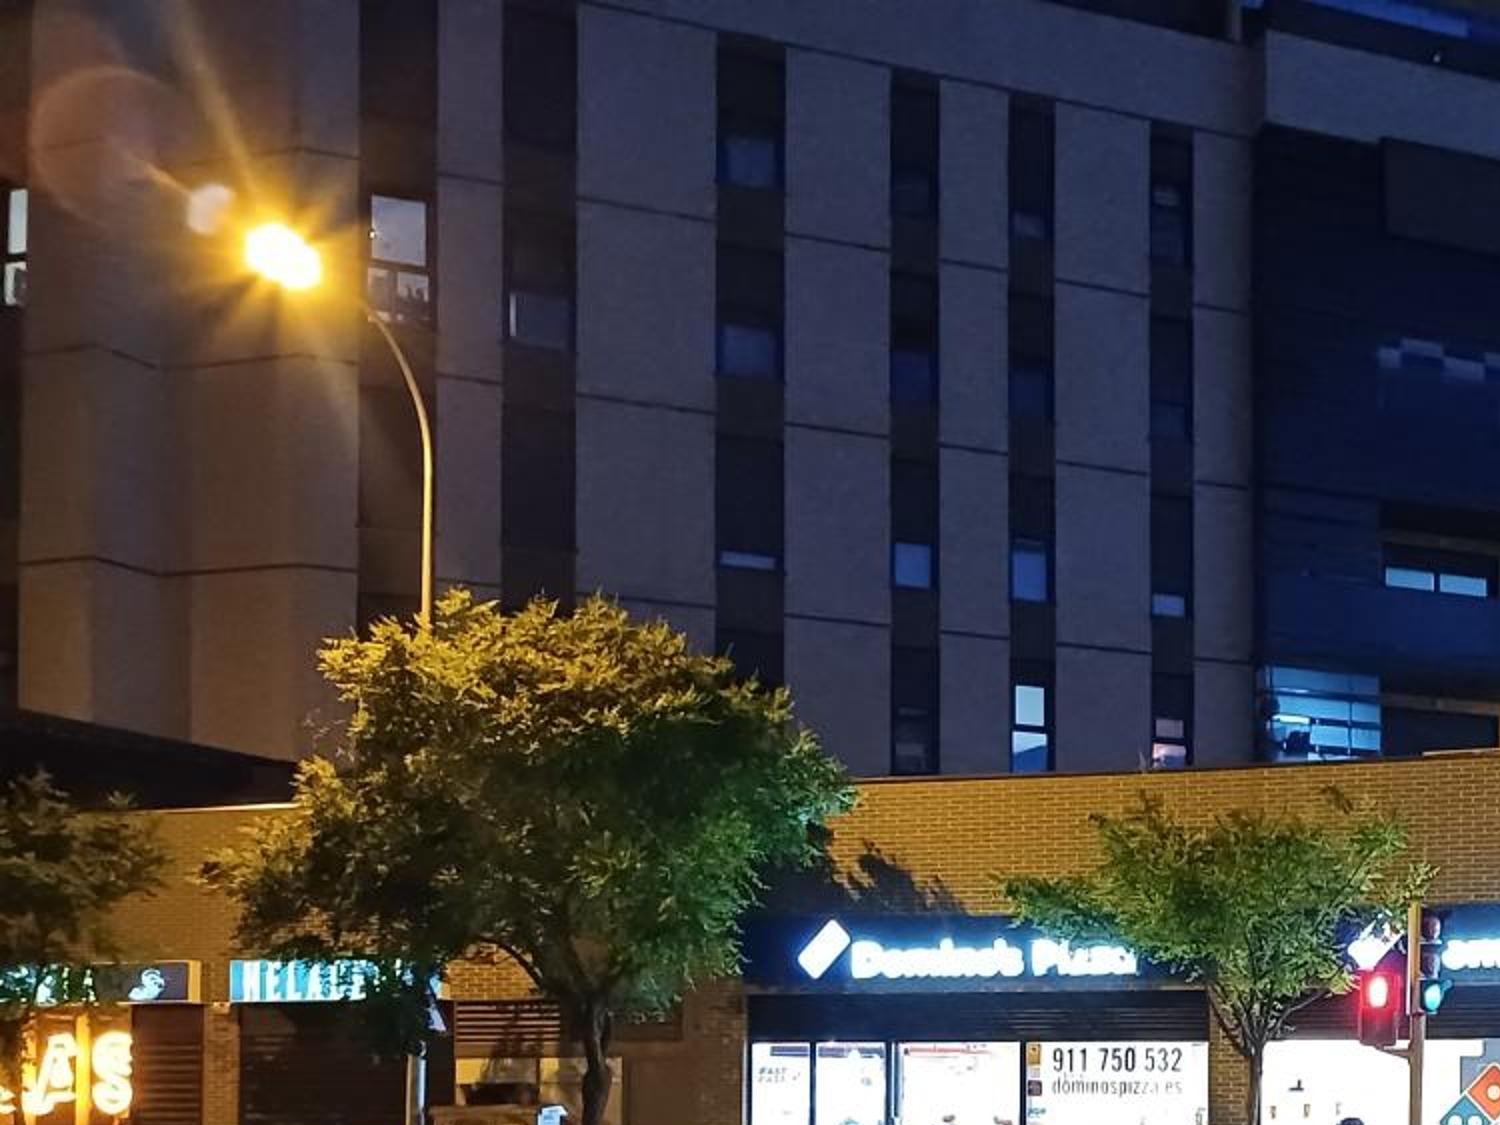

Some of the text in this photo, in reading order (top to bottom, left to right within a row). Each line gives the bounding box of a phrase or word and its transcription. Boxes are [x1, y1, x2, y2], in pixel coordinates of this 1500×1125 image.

[1052, 1047, 1183, 1073] 911 750 532
[1051, 1076, 1184, 1098] dominospizzaes
